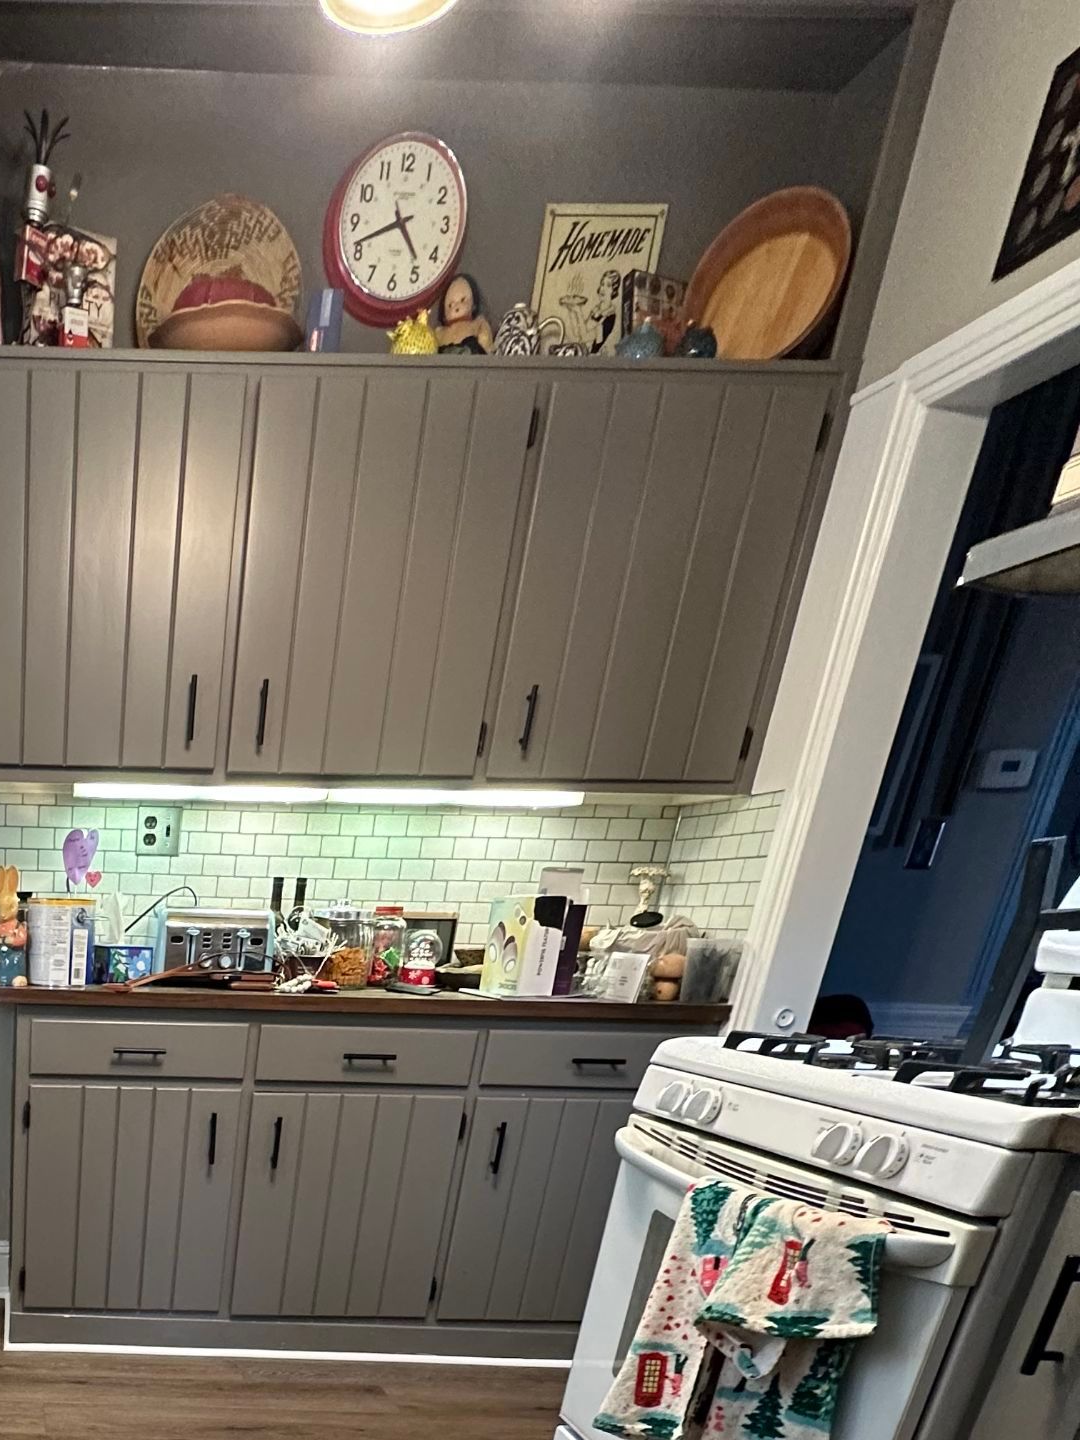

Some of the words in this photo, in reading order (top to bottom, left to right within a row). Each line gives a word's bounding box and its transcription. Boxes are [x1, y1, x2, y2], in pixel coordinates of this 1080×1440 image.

[379, 160, 391, 181] 11
[401, 153, 416, 173] 12
[426, 162, 433, 182] 1
[360, 183, 374, 203] 10
[436, 186, 448, 205] 2
[350, 212, 361, 232] 9
[440, 215, 450, 235] 3
[353, 241, 363, 261] 8
[428, 244, 439, 264] 4
[548, 219, 652, 273] HOMEMADE
[367, 264, 377, 283] 7
[386, 272, 397, 292] 6
[409, 265, 420, 284] 5
